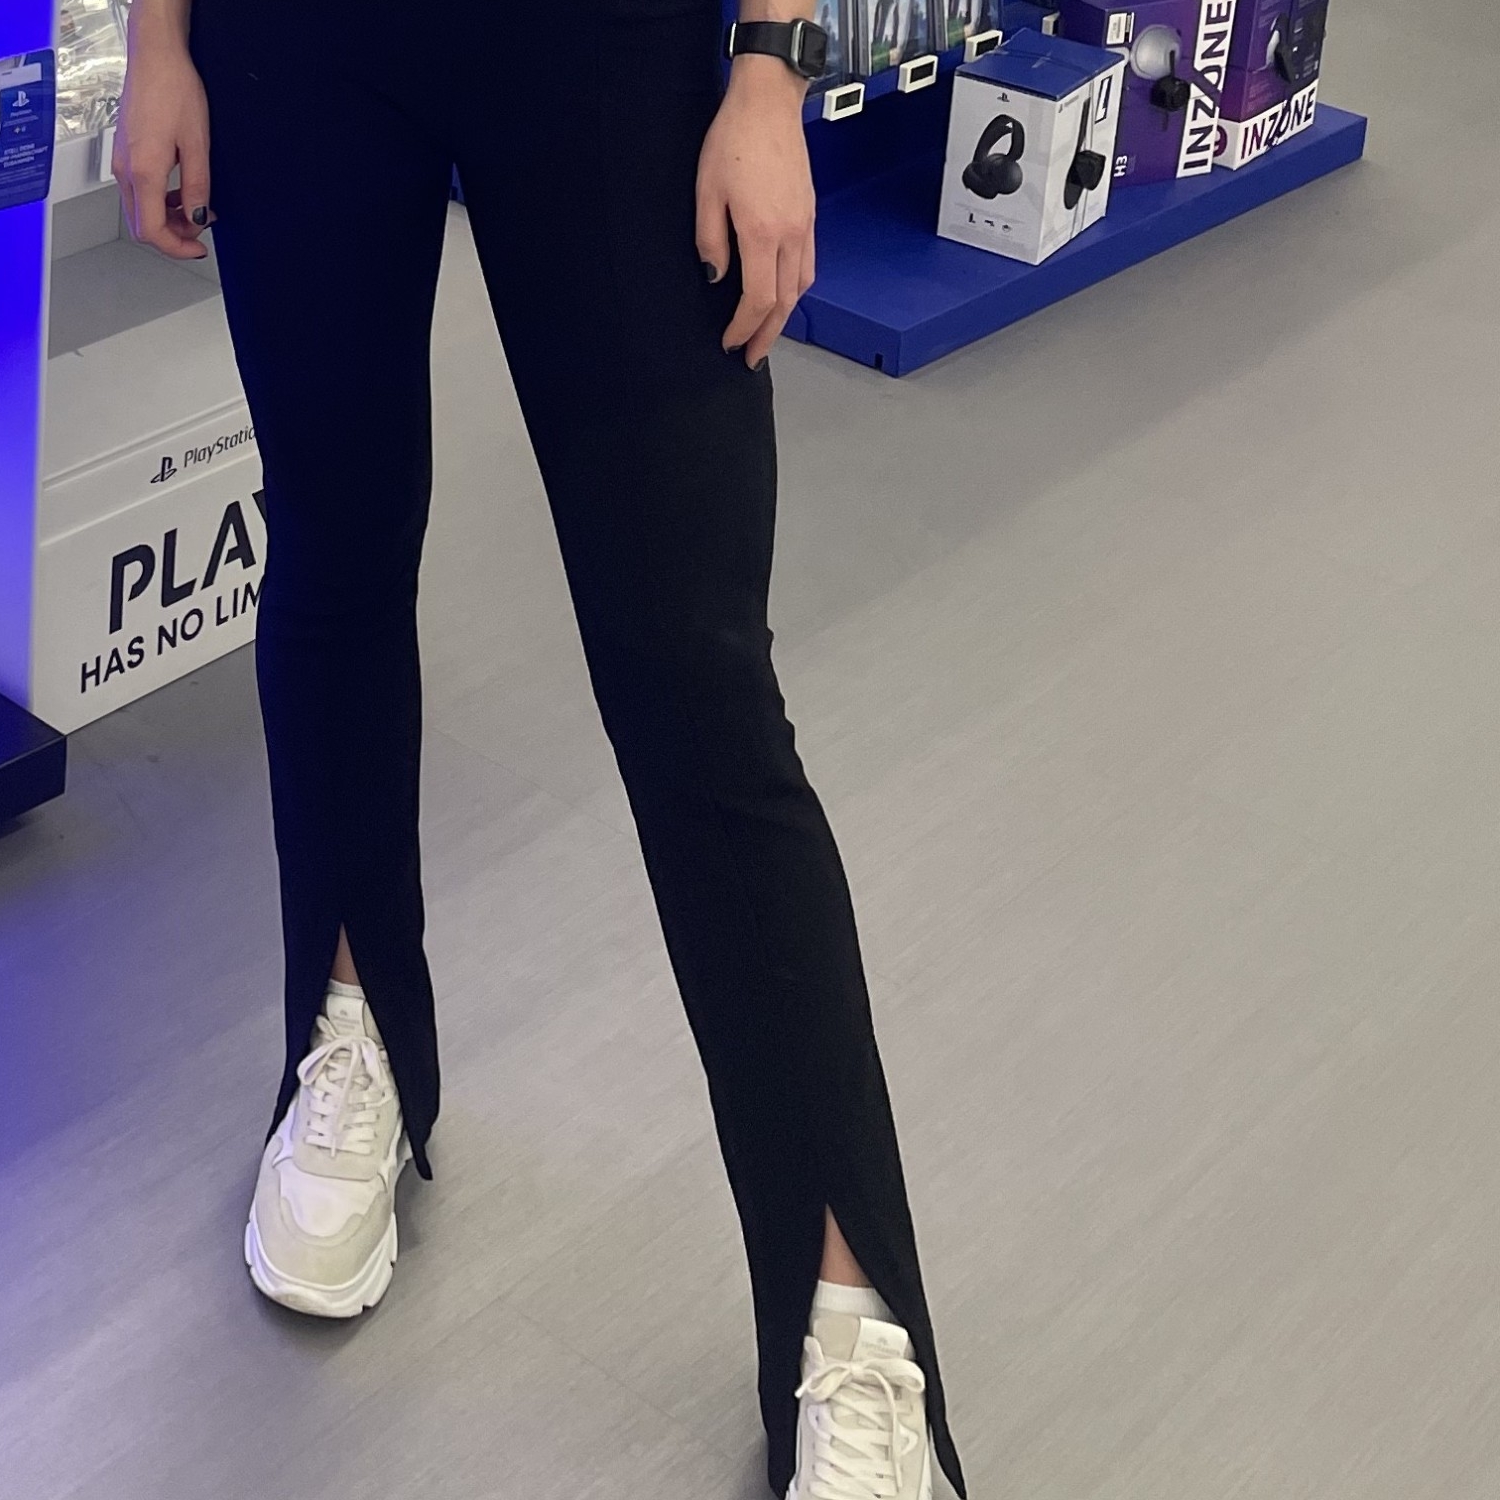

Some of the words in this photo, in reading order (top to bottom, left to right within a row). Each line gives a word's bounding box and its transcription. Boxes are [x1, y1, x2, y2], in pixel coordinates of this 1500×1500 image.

[1182, 0, 1233, 171] INZONE
[1241, 87, 1316, 160] INZONE
[1113, 155, 1128, 177] H3
[80, 634, 145, 694] HAS
[156, 607, 204, 656] NO
